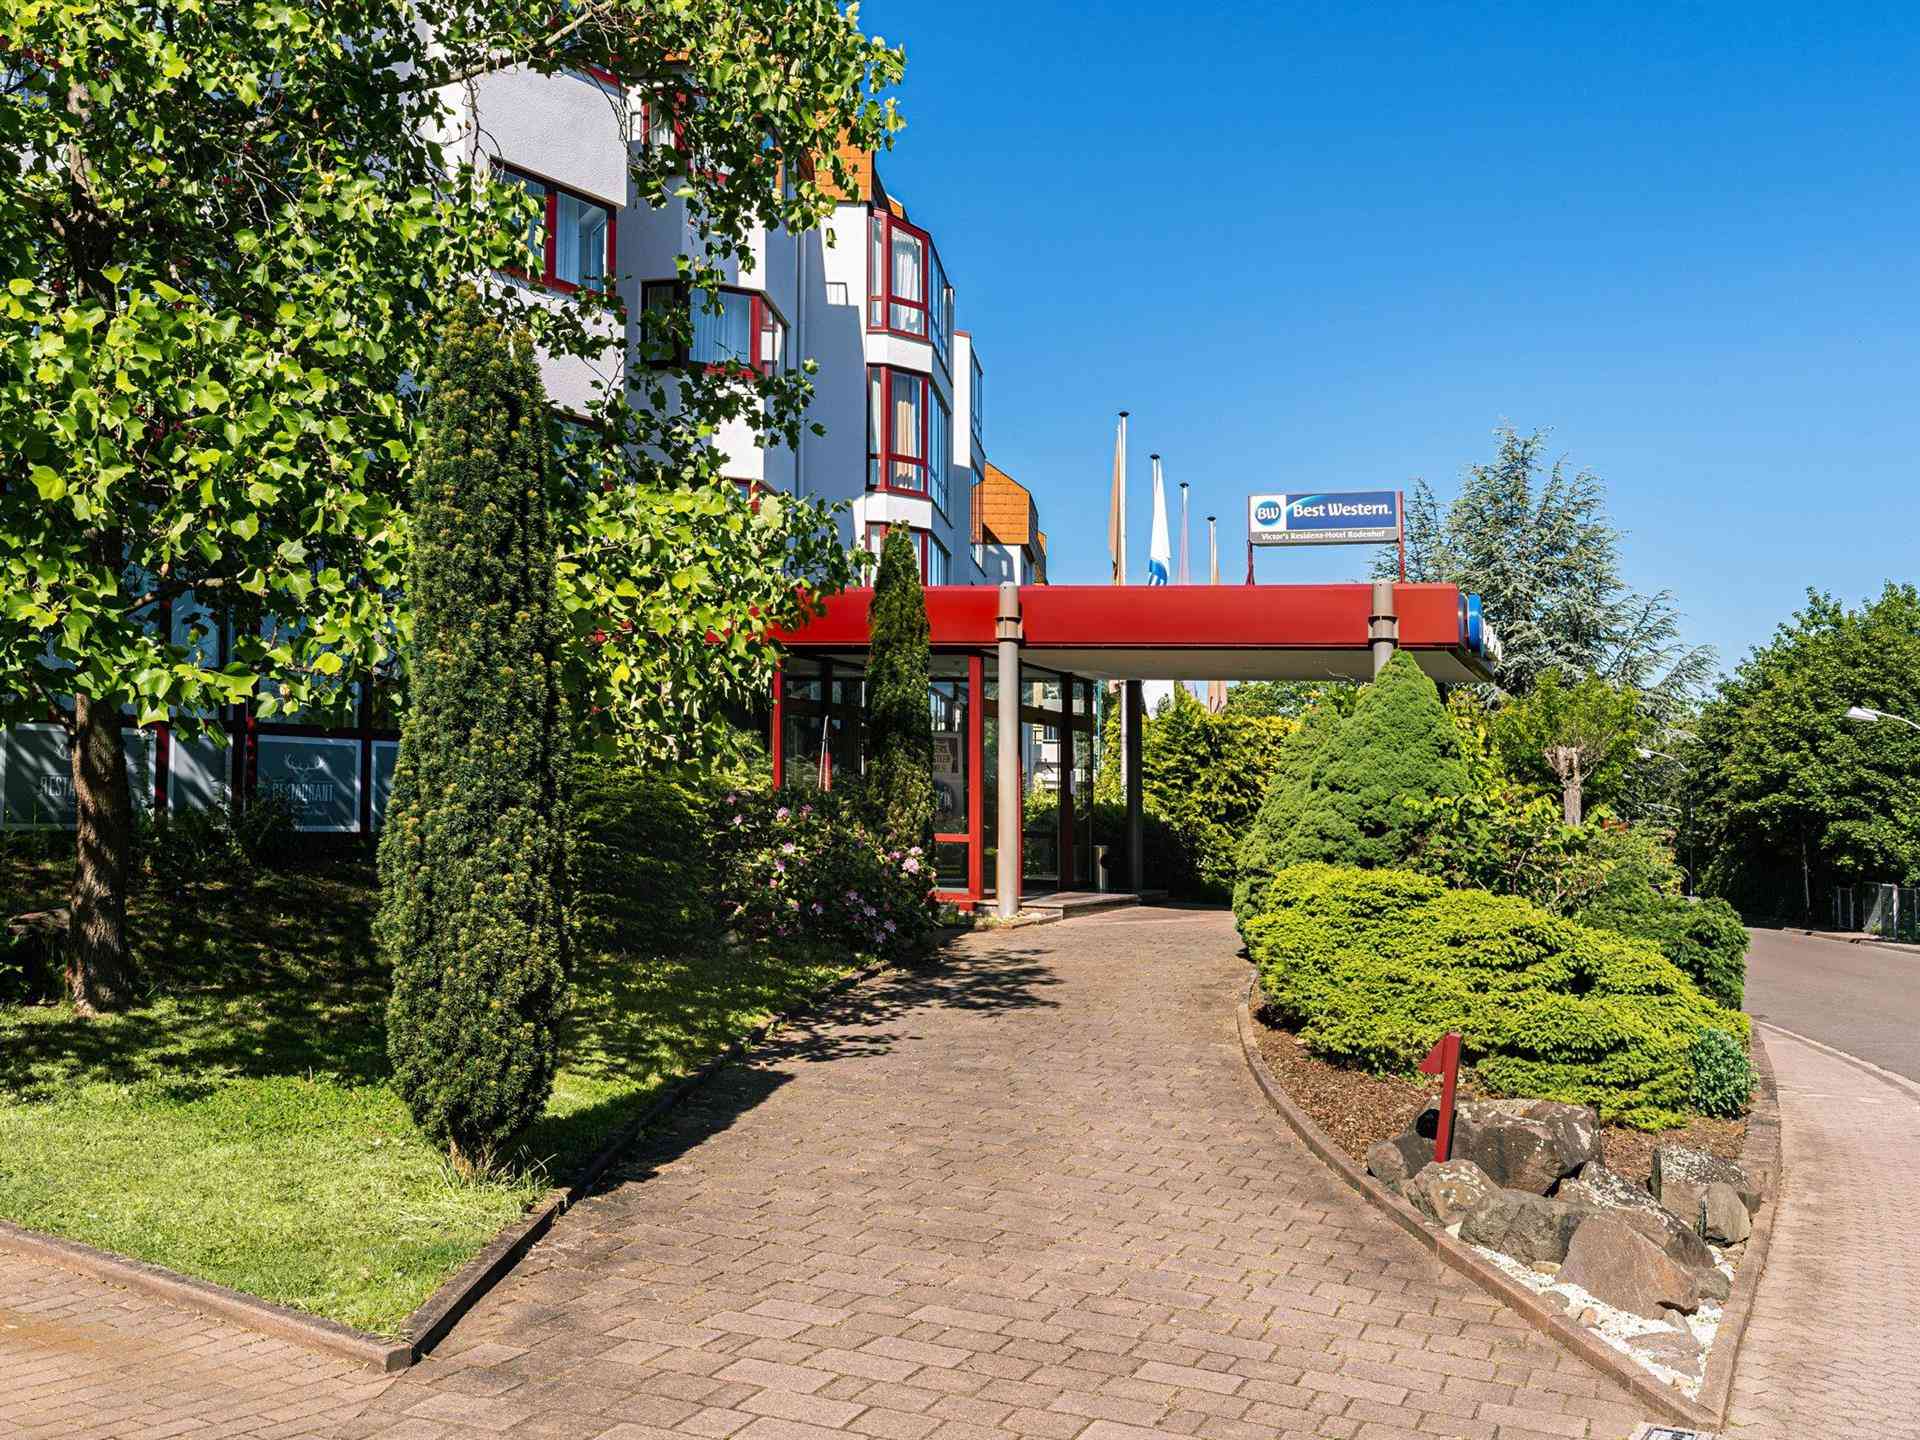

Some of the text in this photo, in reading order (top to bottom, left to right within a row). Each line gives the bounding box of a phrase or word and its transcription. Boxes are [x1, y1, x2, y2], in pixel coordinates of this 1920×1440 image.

[1257, 507, 1279, 520] BW
[1294, 504, 1325, 517] Best
[1261, 533, 1289, 541] Victor's
